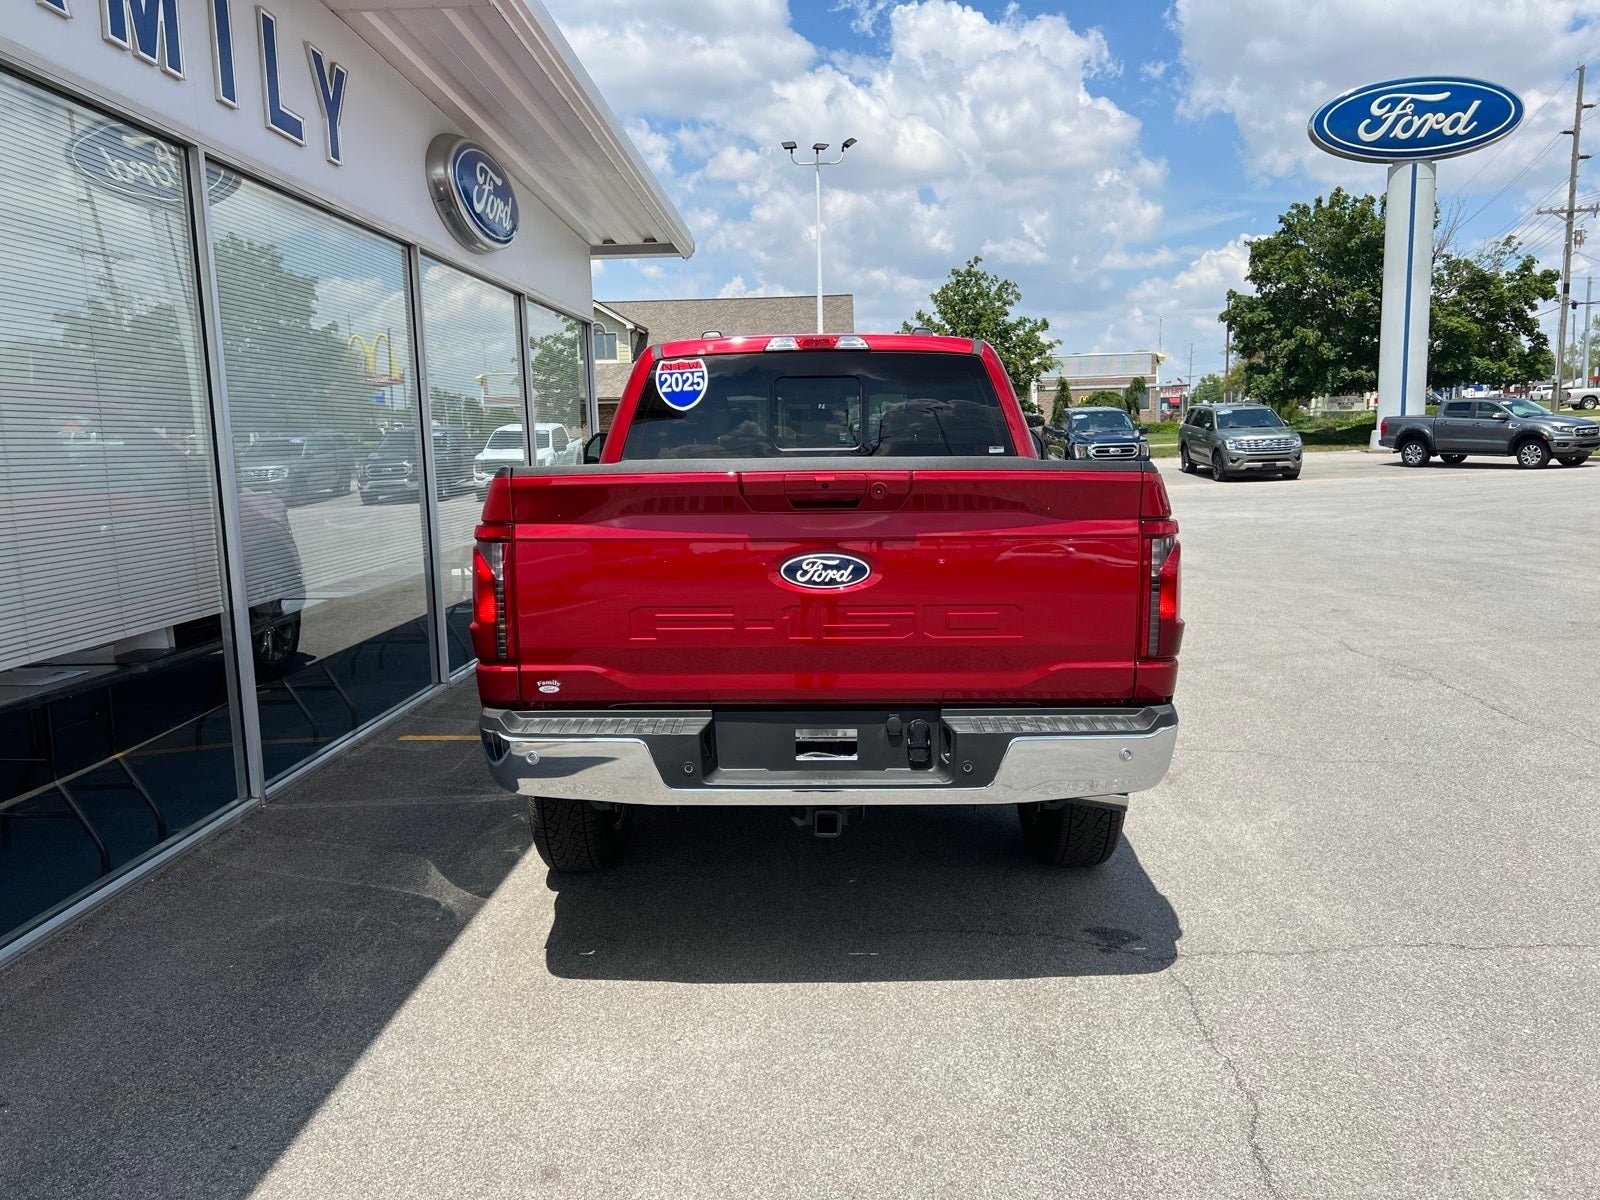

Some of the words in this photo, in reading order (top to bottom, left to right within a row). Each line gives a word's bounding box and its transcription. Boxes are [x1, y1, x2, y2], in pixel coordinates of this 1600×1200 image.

[1357, 91, 1482, 143] Ford
[472, 160, 513, 231] Ford
[660, 371, 704, 393] 2025
[796, 558, 854, 582] Ford
[628, 604, 1024, 641] F-150
